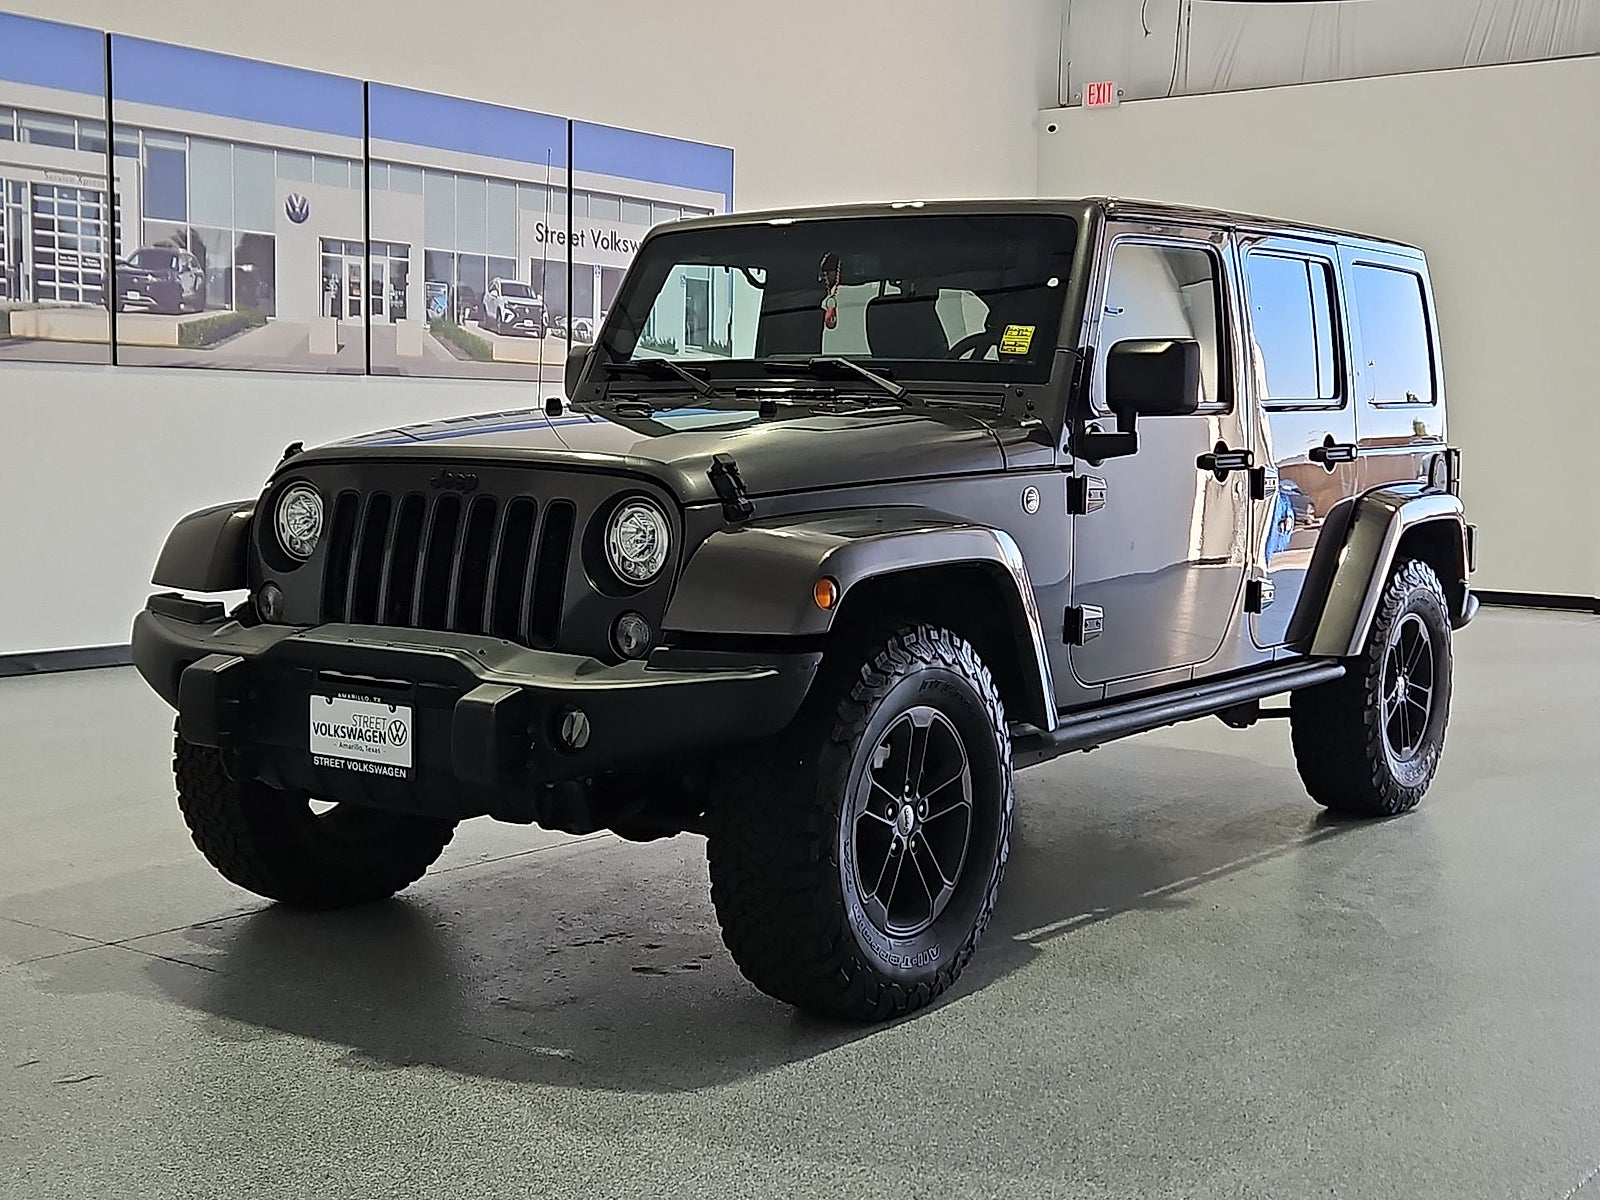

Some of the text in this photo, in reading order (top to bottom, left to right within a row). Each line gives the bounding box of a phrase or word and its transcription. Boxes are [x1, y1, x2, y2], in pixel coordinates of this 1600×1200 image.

[1088, 82, 1112, 105] EXIT
[535, 222, 585, 248] Street
[312, 721, 387, 745] VOLKSWAGEN
[352, 714, 387, 731] STREET
[364, 745, 382, 754] Texas
[313, 756, 407, 778] STREET VOLKSWAGEN
